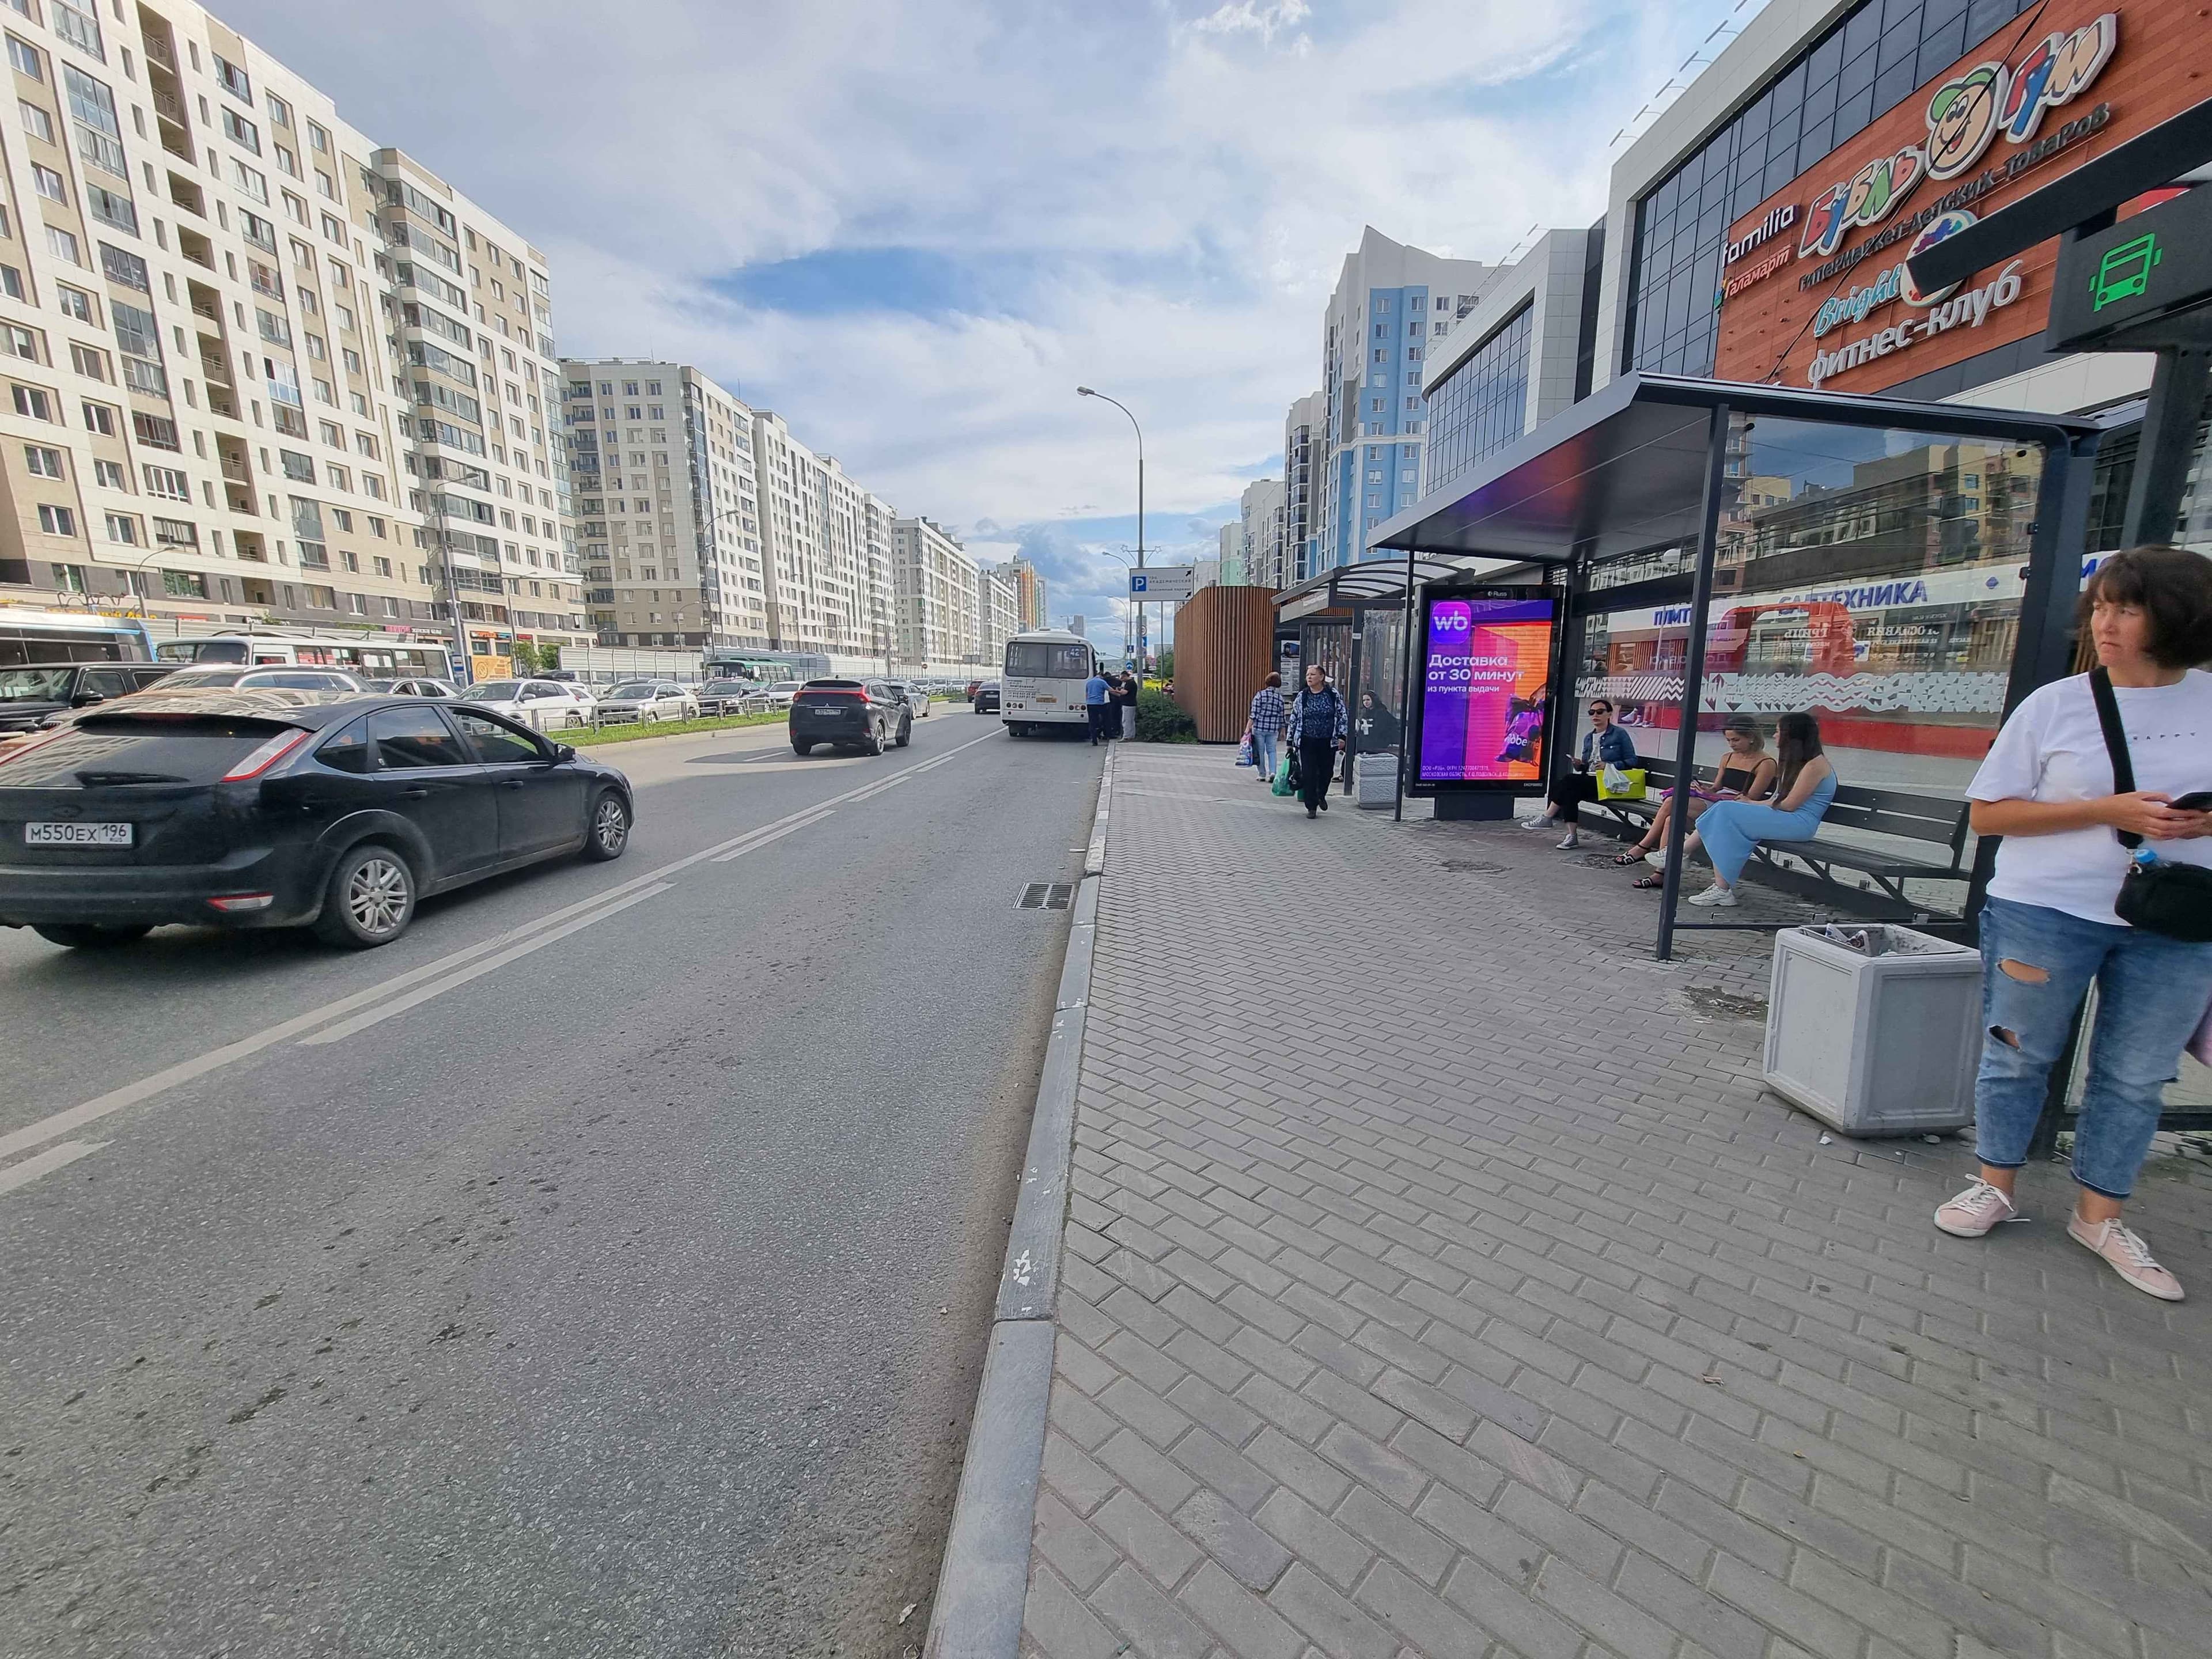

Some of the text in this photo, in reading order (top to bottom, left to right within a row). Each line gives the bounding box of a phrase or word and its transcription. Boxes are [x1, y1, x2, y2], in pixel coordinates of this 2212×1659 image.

[1722, 204, 1796, 268] familia
[1814, 263, 1902, 338] Bright
[1434, 610, 1468, 631] wb
[1070, 648, 1080, 656] 42
[1429, 654, 1508, 668] Доставка
[1428, 669, 1525, 683] от 30 минут
[1439, 686, 1467, 694] пункта
[101, 824, 126, 838] 196
